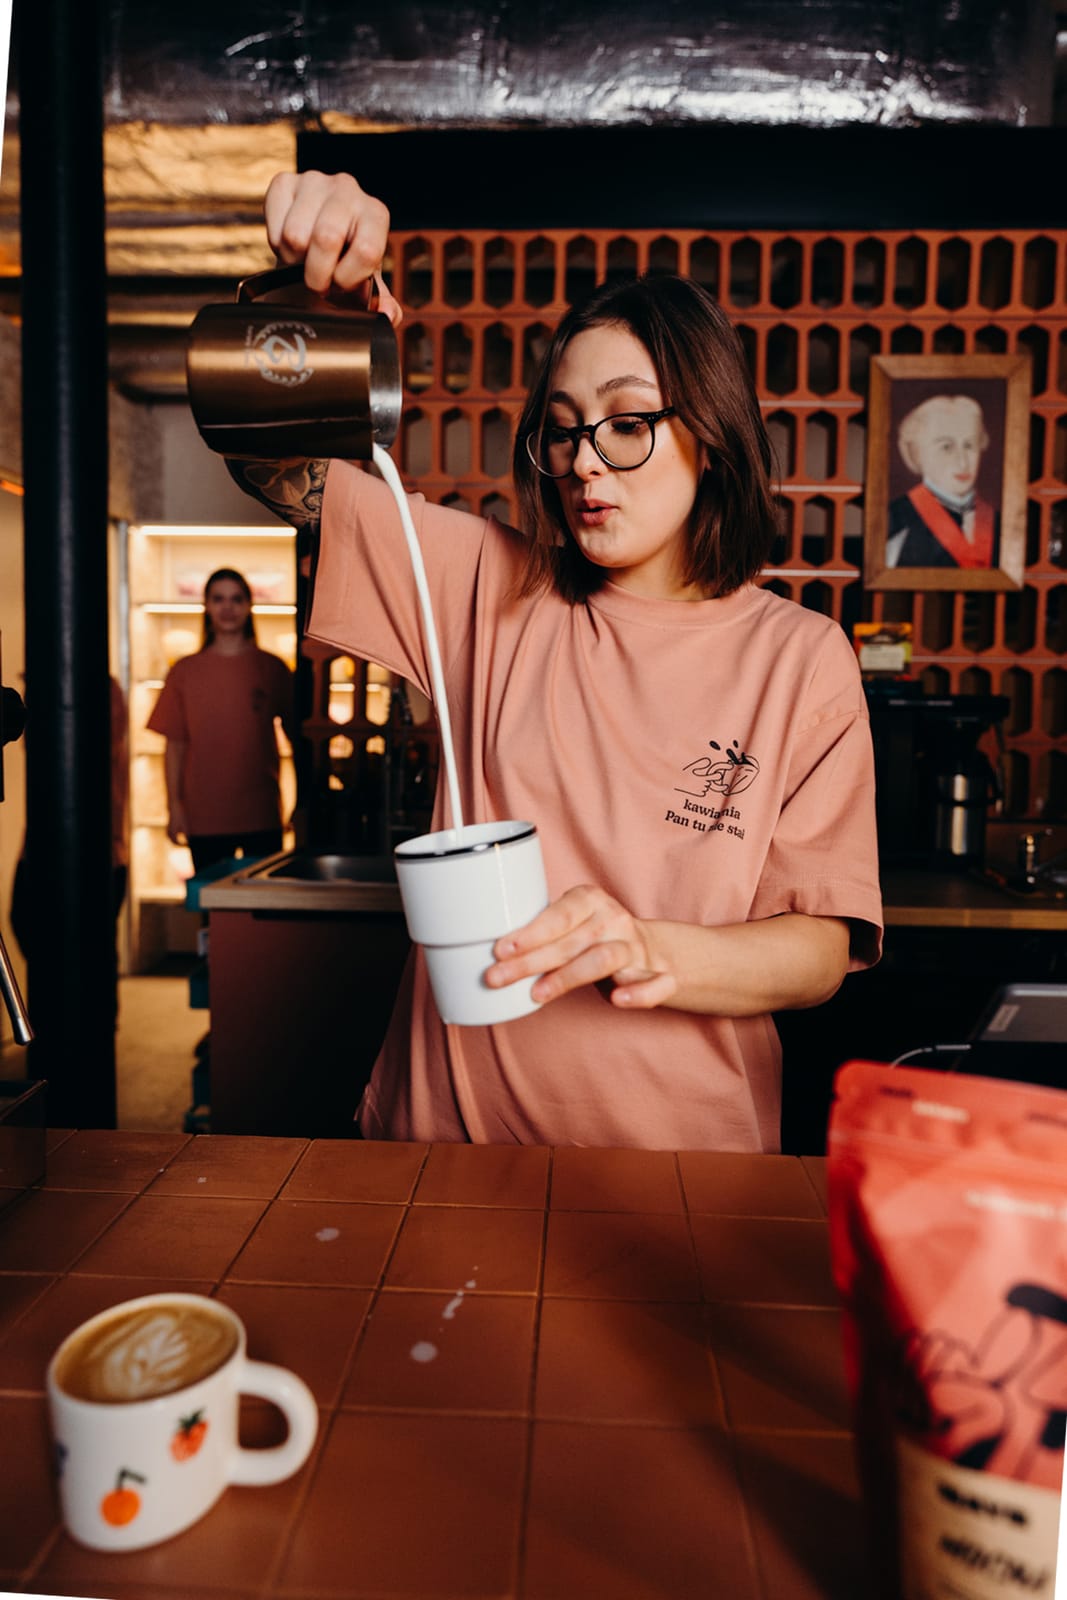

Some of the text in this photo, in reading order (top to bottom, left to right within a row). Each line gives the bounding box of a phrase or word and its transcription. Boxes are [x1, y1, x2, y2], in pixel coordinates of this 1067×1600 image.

[683, 799, 741, 820] kawiania
[665, 810, 689, 827] Pan
[693, 820, 706, 832] tu
